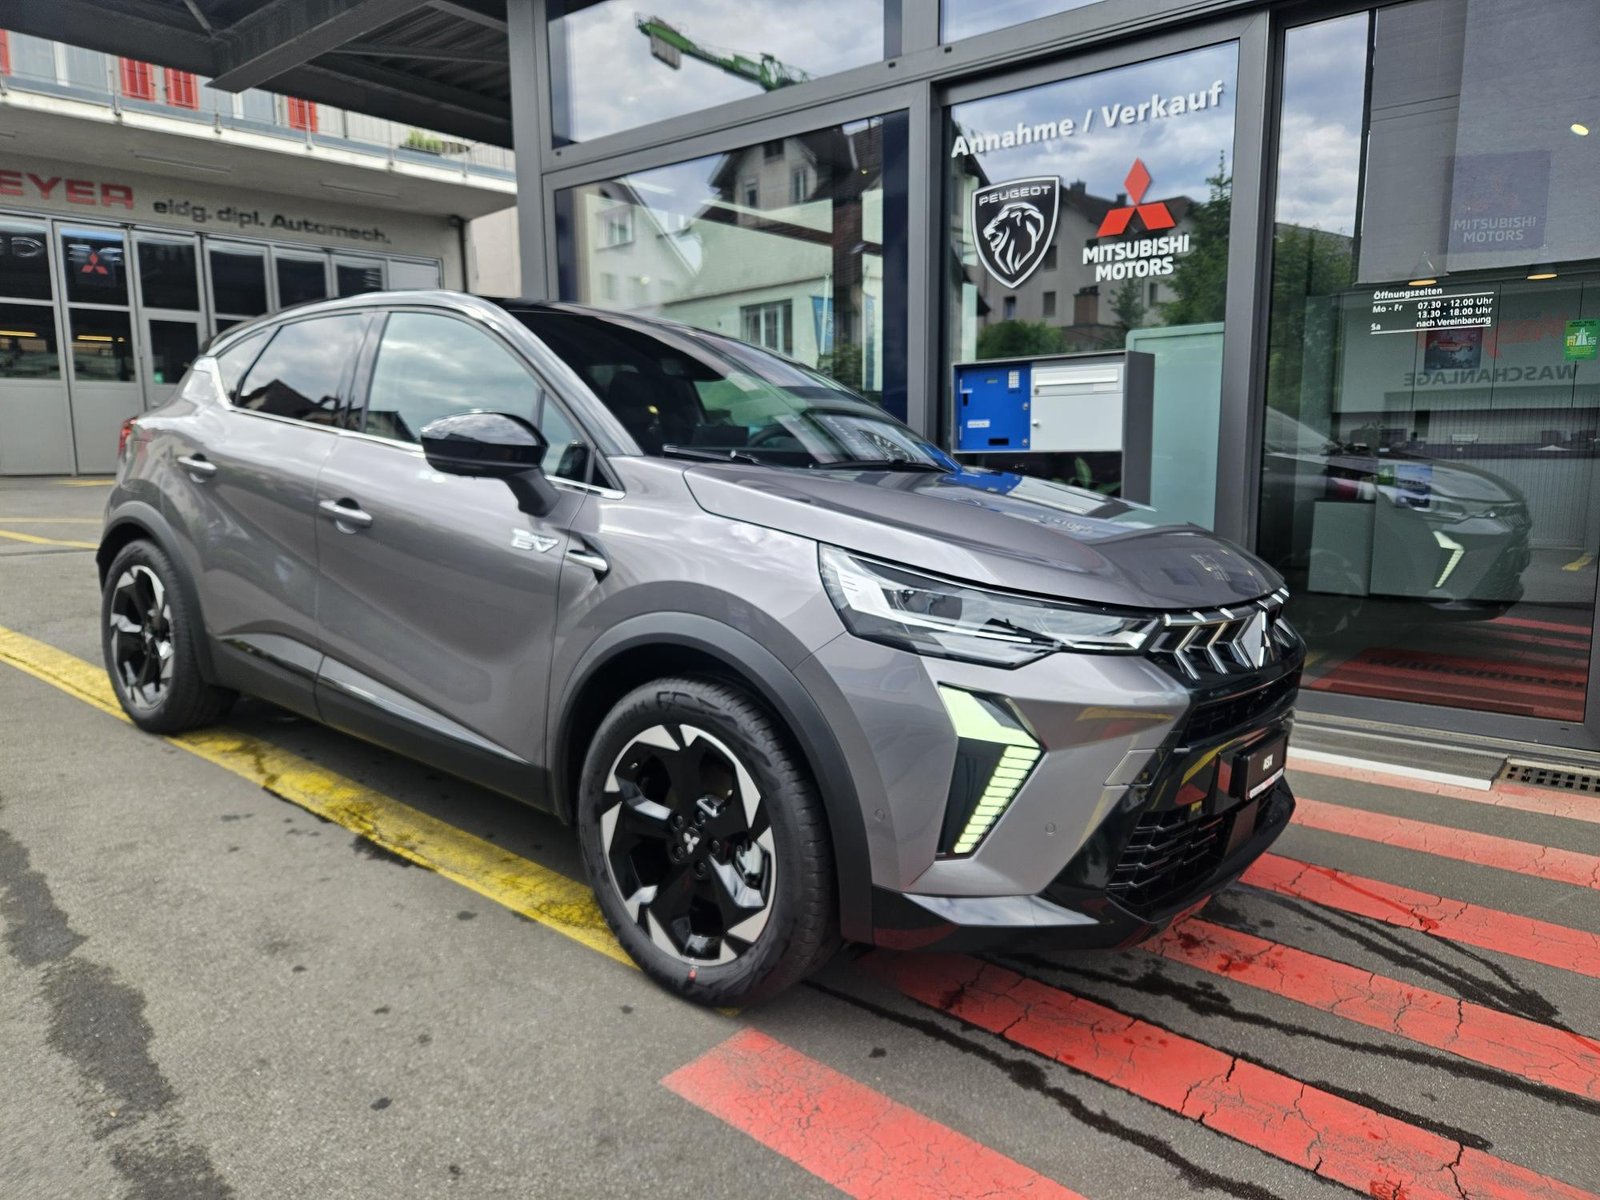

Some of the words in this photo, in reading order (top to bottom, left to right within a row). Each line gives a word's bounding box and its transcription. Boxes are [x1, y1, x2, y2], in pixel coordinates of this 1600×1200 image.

[951, 117, 1076, 158] Annahme
[1082, 109, 1092, 132] /
[1101, 80, 1224, 128] Verkauf
[979, 185, 1052, 207] PEUGEOT
[217, 206, 266, 229] dipl.
[269, 213, 392, 245] Automech.
[1453, 216, 1536, 231] MITSUBISHI
[1463, 229, 1525, 243] MOTORS
[1082, 234, 1190, 265] MITSUBISHI
[1095, 256, 1175, 283] MOTORS
[1373, 287, 1443, 300] Öffnungszeiten
[1372, 304, 1387, 313] Mo
[1394, 303, 1403, 312] Fr
[1417, 301, 1441, 310] 07.30
[1450, 298, 1474, 307] 12.00
[1476, 297, 1493, 305] Uhr
[1417, 310, 1441, 318] 13.30
[1449, 307, 1473, 316] 18.00
[1475, 306, 1493, 314] Uhr
[1370, 322, 1381, 331] Sa
[1416, 319, 1435, 328] nach
[1437, 316, 1491, 326] Vereinbarung
